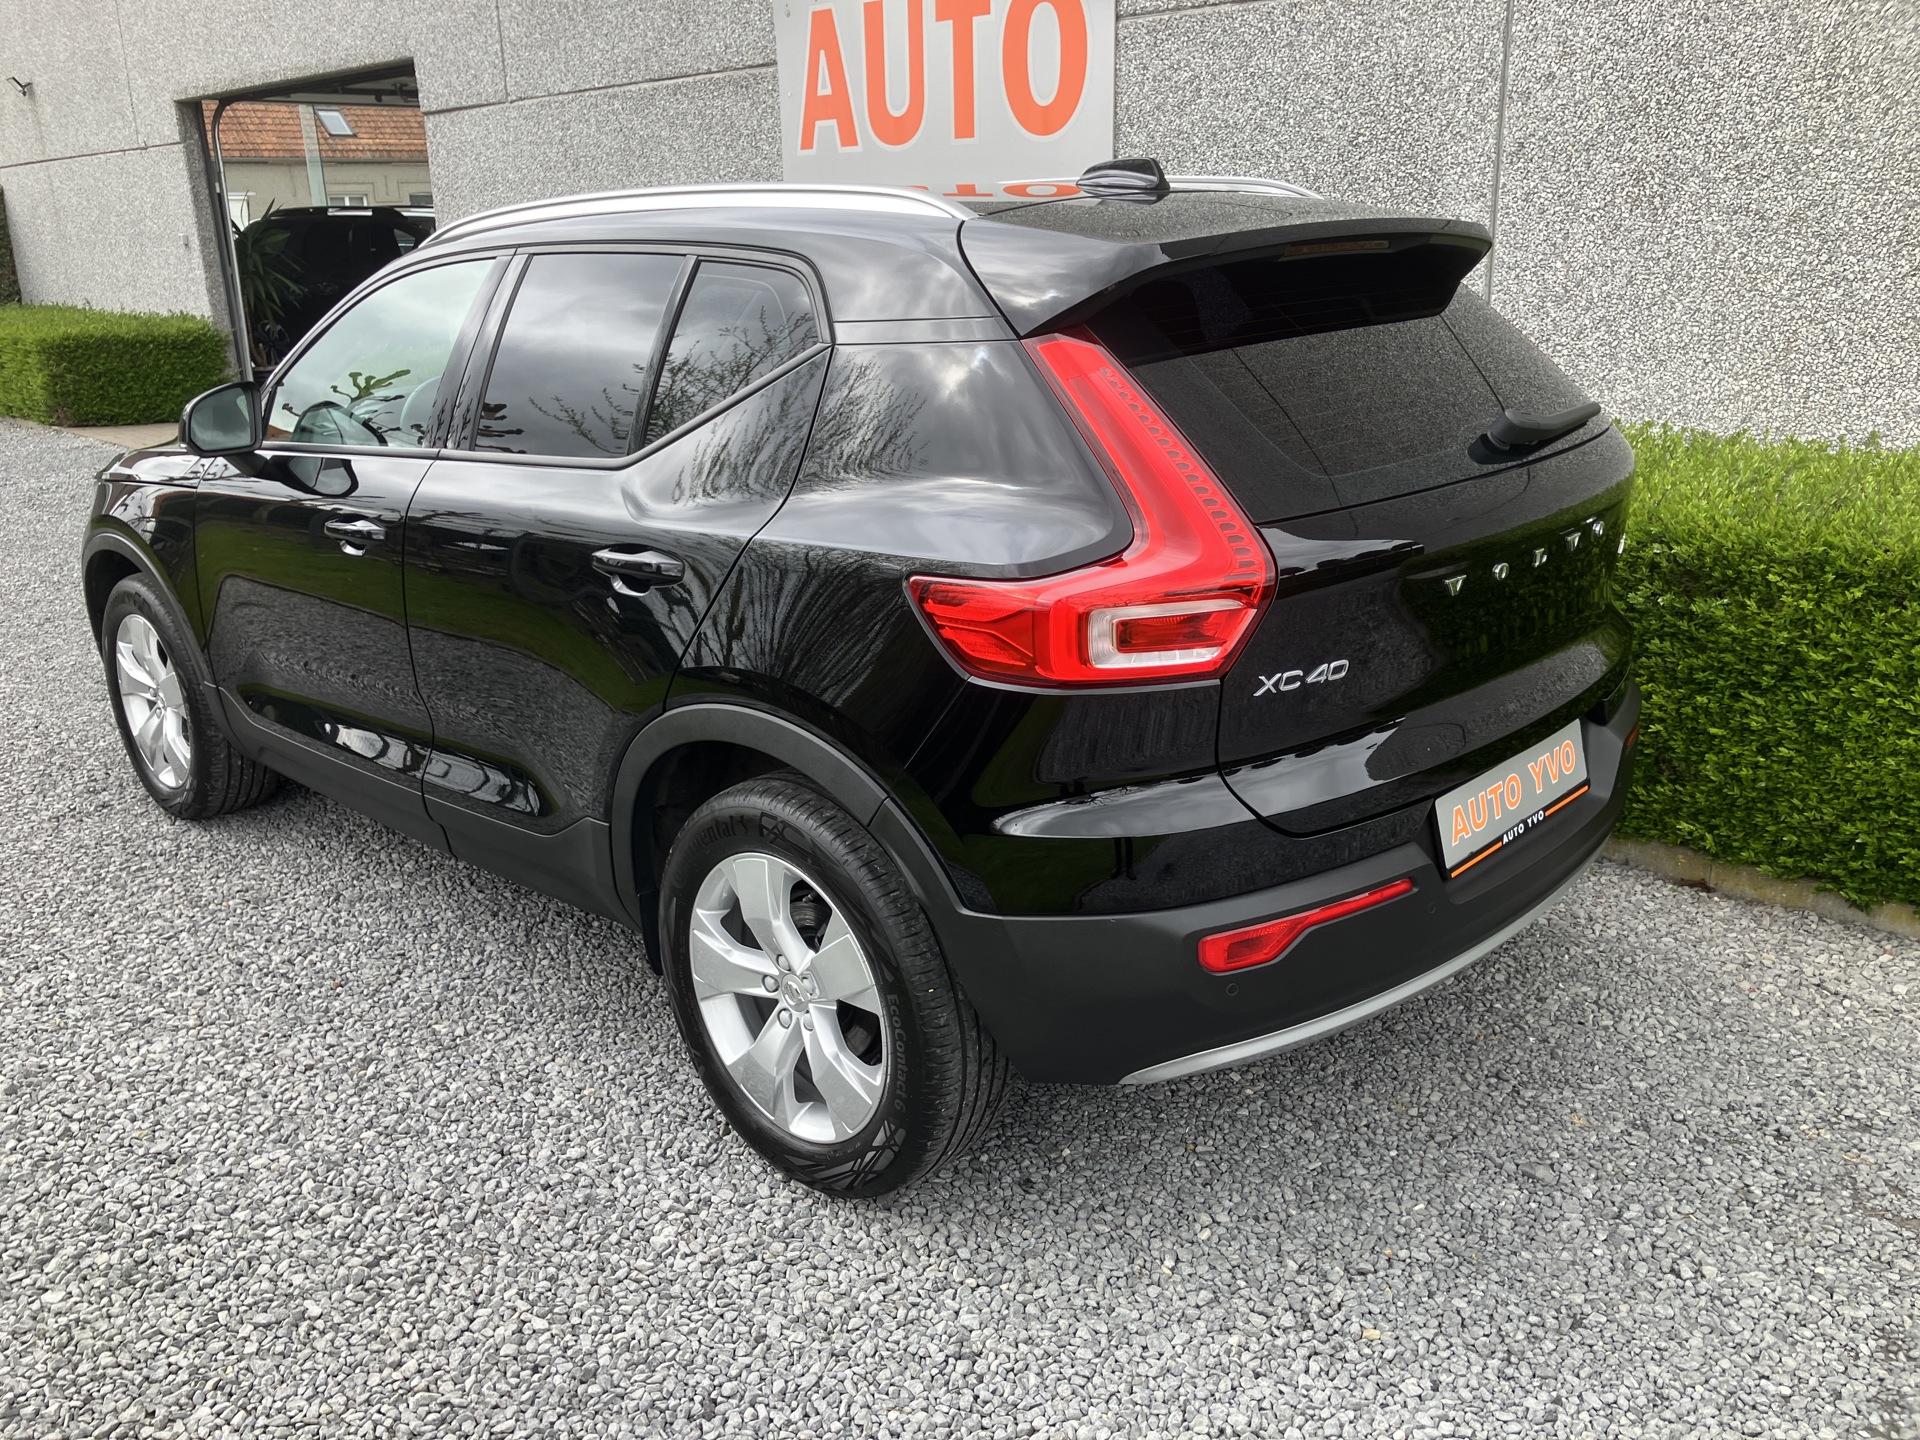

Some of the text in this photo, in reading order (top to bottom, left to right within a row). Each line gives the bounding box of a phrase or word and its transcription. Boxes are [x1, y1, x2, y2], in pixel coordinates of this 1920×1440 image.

[800, 0, 1088, 150] AUTO
[1443, 520, 1605, 597] VOLVO
[1452, 740, 1576, 847] AUTO YVO
[1503, 810, 1544, 845] AUTO YVO
[886, 994, 908, 1098] EcoContact
